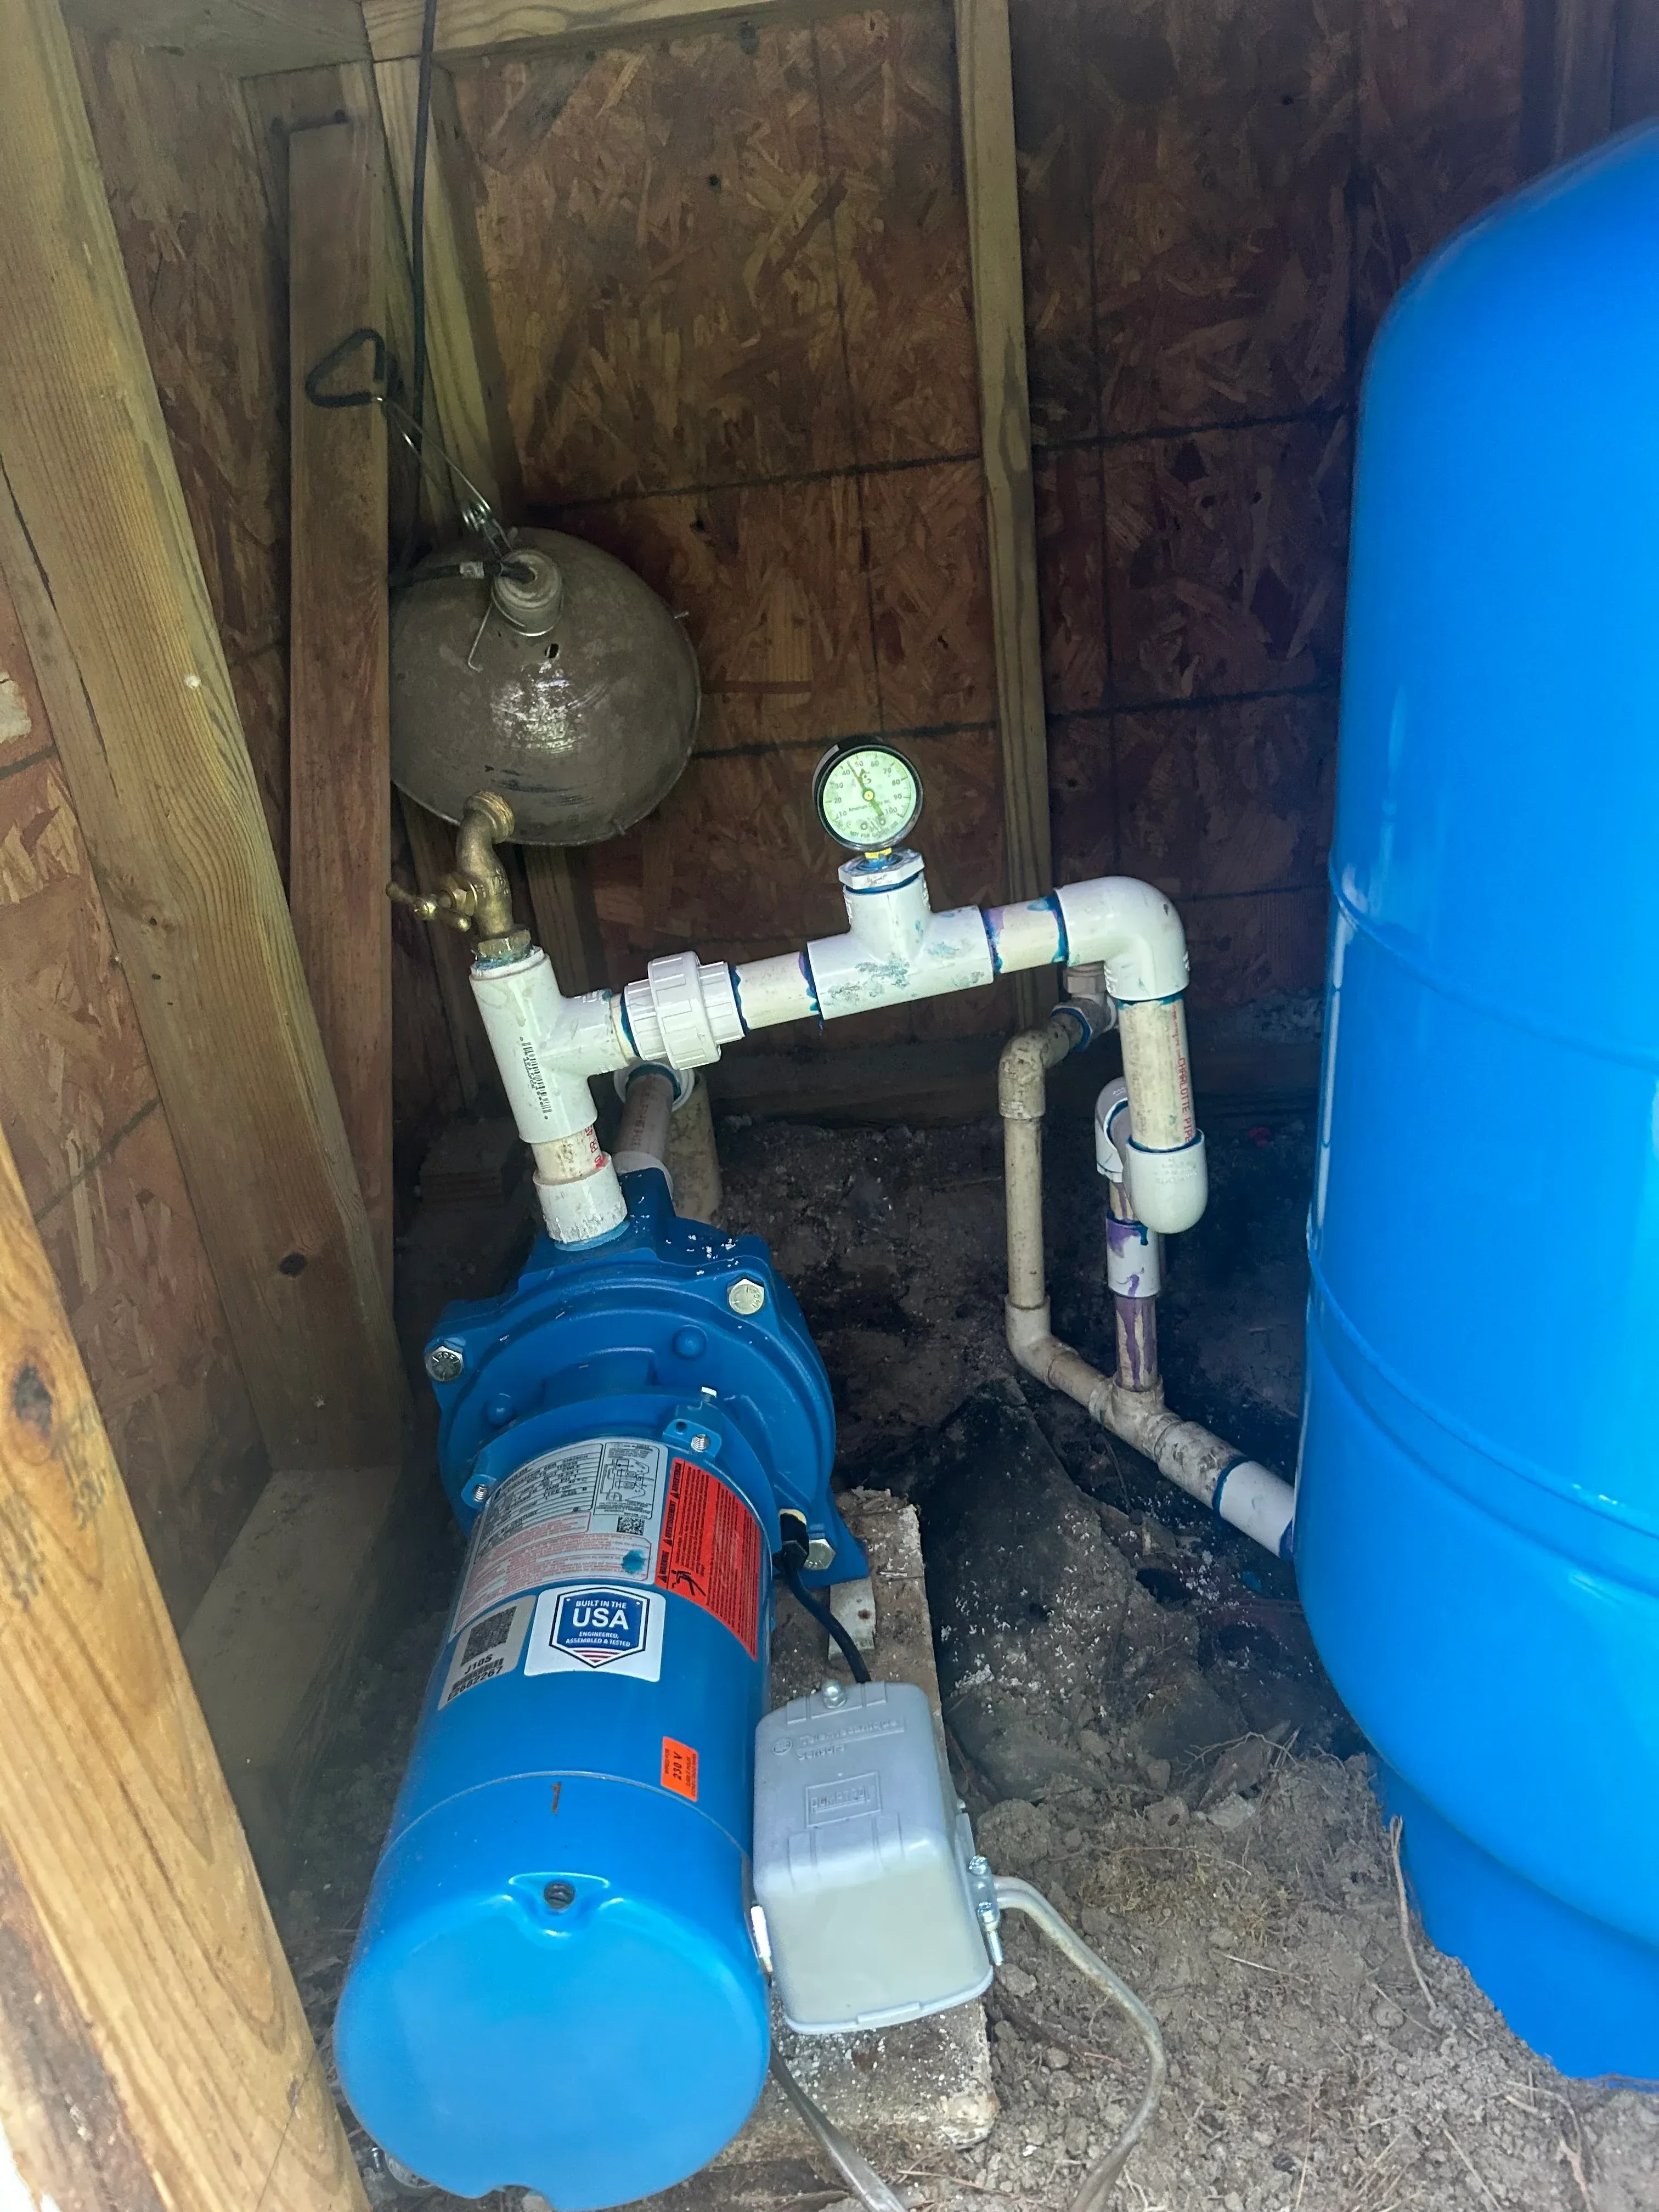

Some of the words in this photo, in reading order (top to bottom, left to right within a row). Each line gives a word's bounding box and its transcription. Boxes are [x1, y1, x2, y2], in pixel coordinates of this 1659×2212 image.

[1178, 1057, 1190, 1114] CHARLOTTE
[1184, 1117, 1193, 1143] PIPE
[584, 1125, 593, 1136] 45
[590, 1138, 599, 1153] PR
[573, 1607, 629, 1630] USA
[610, 1638, 631, 1646] TESTED
[464, 1654, 493, 1675] J10S
[674, 1751, 682, 1759] V
[673, 1762, 681, 1780] 230
